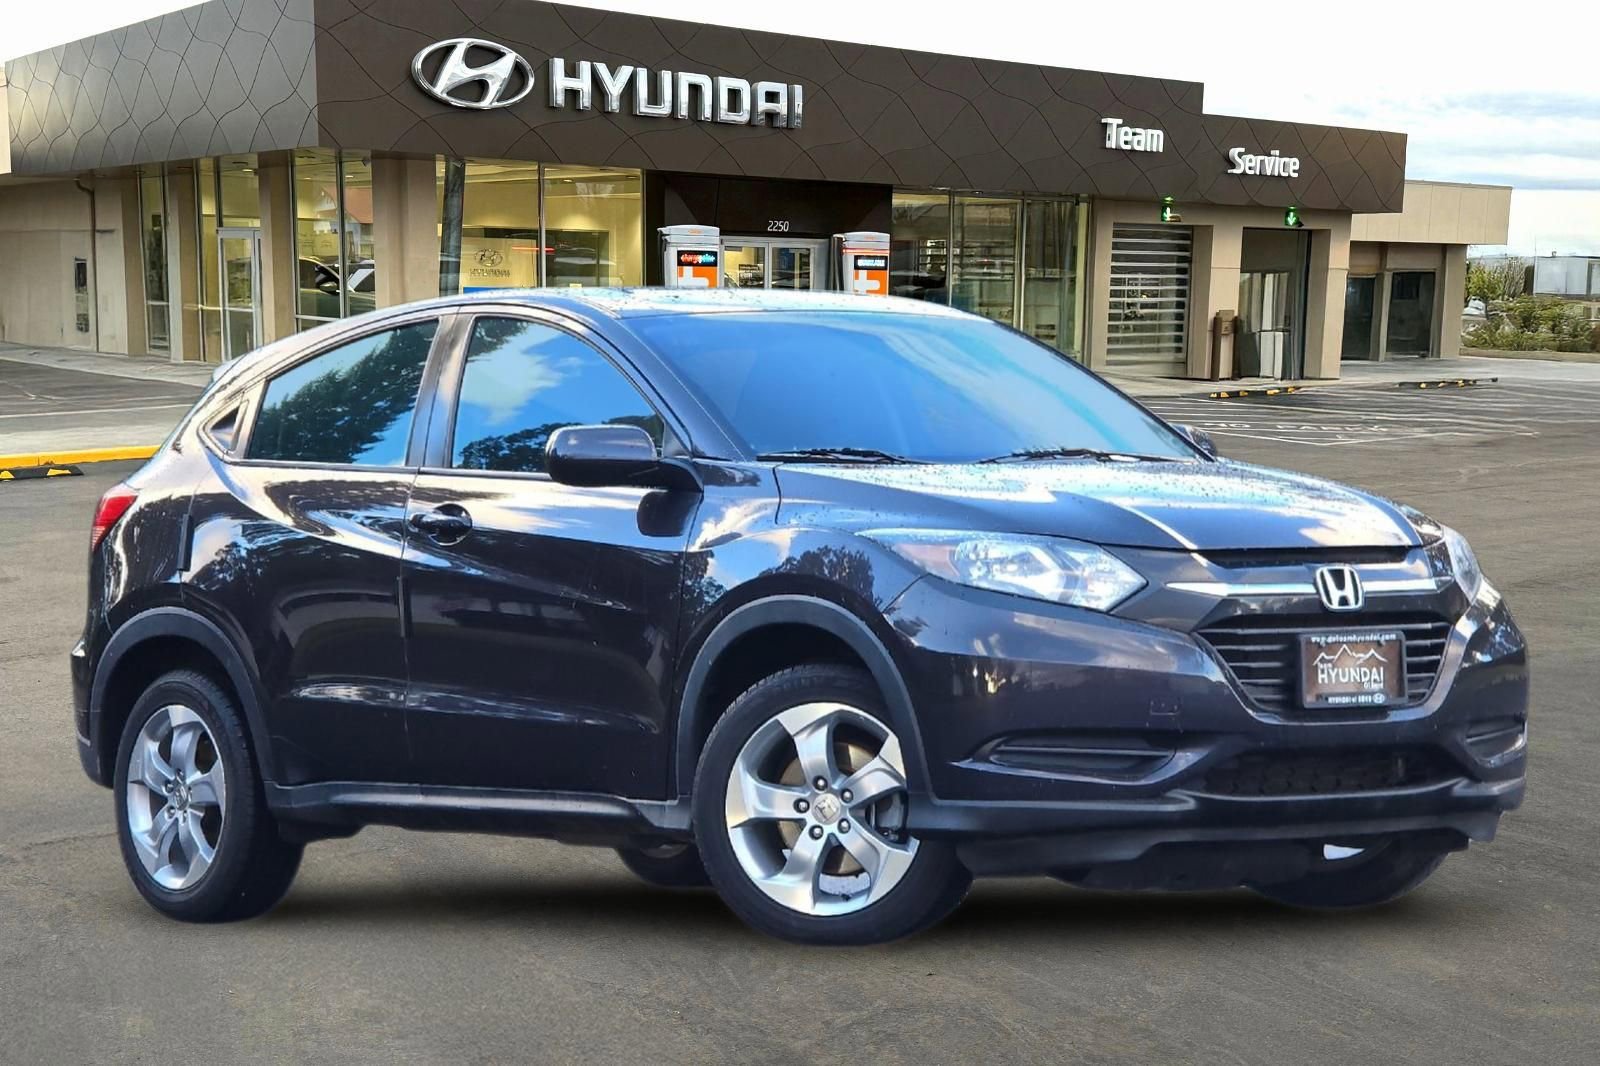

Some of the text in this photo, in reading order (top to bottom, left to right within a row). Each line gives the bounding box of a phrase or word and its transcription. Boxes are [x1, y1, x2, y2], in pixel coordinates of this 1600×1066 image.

[548, 56, 803, 129] HYUNDAI
[1101, 117, 1164, 153] Team
[1227, 147, 1300, 178] Service
[767, 220, 790, 232] 2250
[1317, 666, 1384, 684] HYUNDAI
